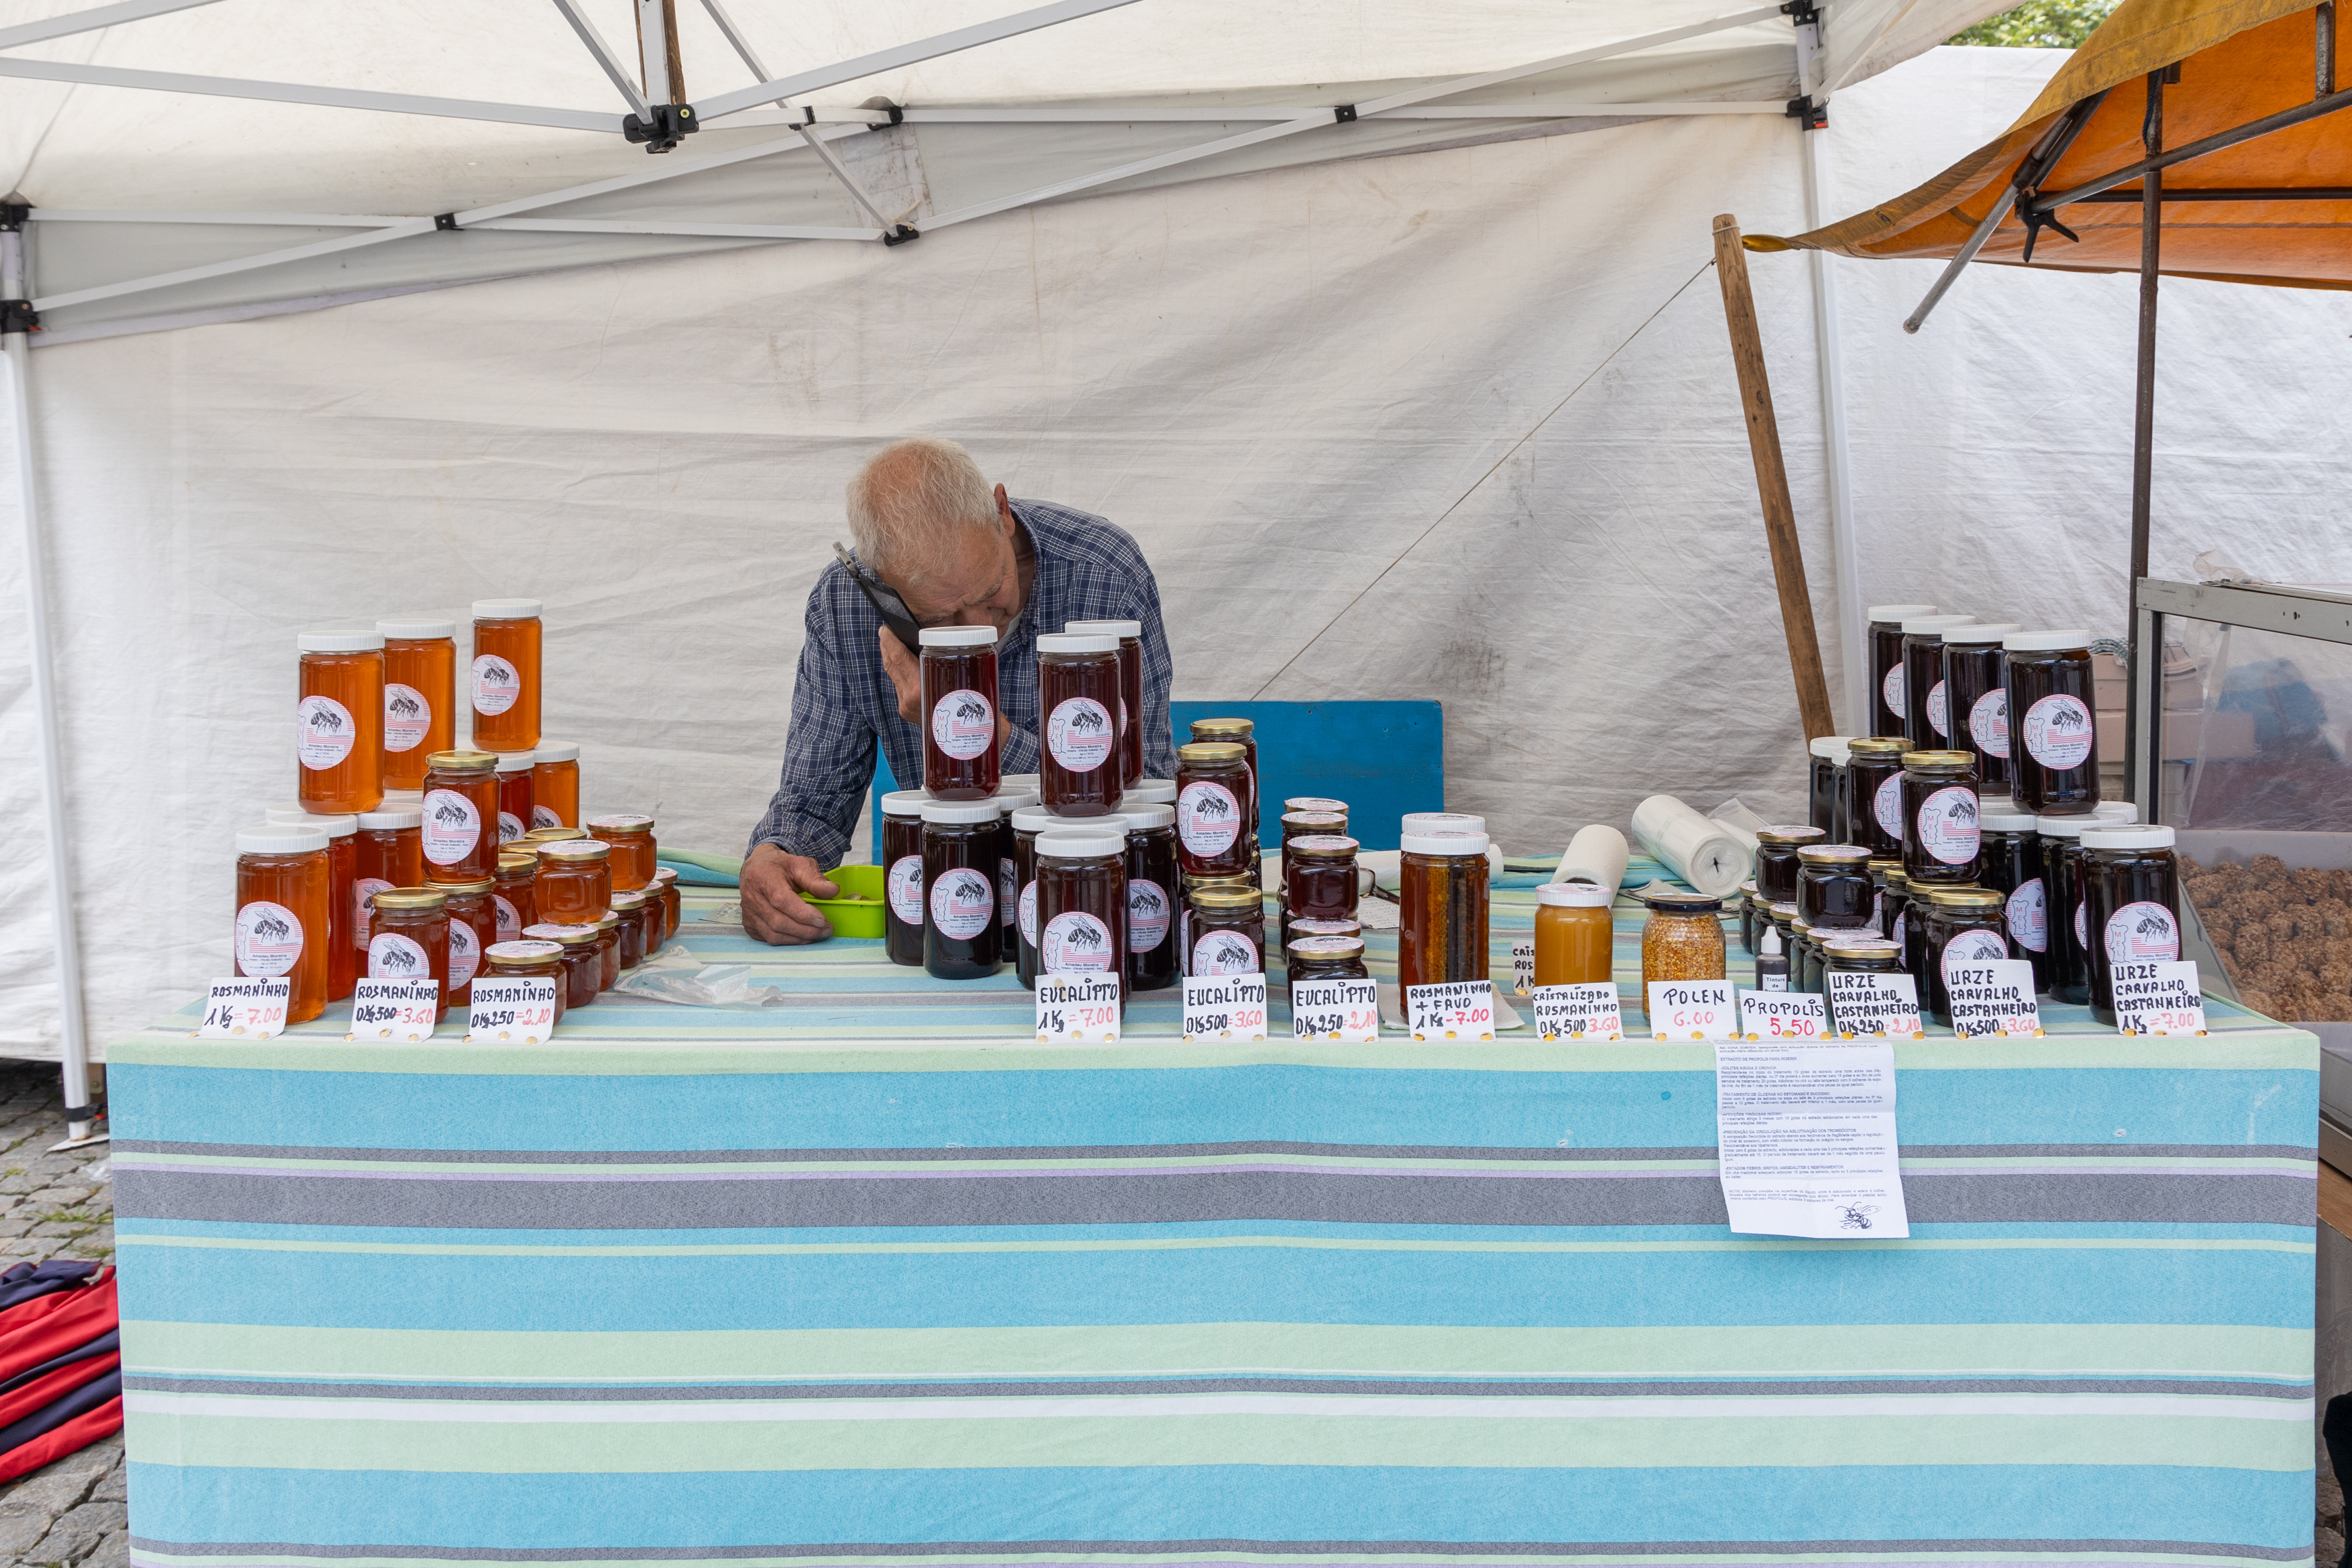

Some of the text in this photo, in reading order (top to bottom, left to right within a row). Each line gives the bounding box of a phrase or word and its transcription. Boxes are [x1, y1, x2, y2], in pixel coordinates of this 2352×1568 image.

[1950, 969, 1994, 985] URZE
[2115, 963, 2157, 981] URZE
[1515, 975, 1524, 988] 1
[1832, 974, 1876, 989] URZE
[2115, 979, 2184, 996] CARVALHO
[1663, 988, 1726, 1006] POLEN
[1832, 989, 1897, 1003] CARVALHO
[1951, 986, 2018, 1001] CARVALHO
[1434, 997, 1471, 1010] FAVO
[204, 1008, 217, 1025] 1
[220, 1005, 233, 1029] Kg
[248, 1007, 281, 1025] 7.00
[1038, 1012, 1048, 1030] 1
[1051, 1009, 1064, 1033] Kg
[1079, 1006, 1114, 1028] 7.00
[1416, 1015, 1425, 1029] 1
[1455, 1008, 1489, 1025] 7.00
[1674, 1011, 1714, 1027] 6.00
[2122, 1015, 2130, 1031] 1
[2161, 1013, 2194, 1029] 7.00
